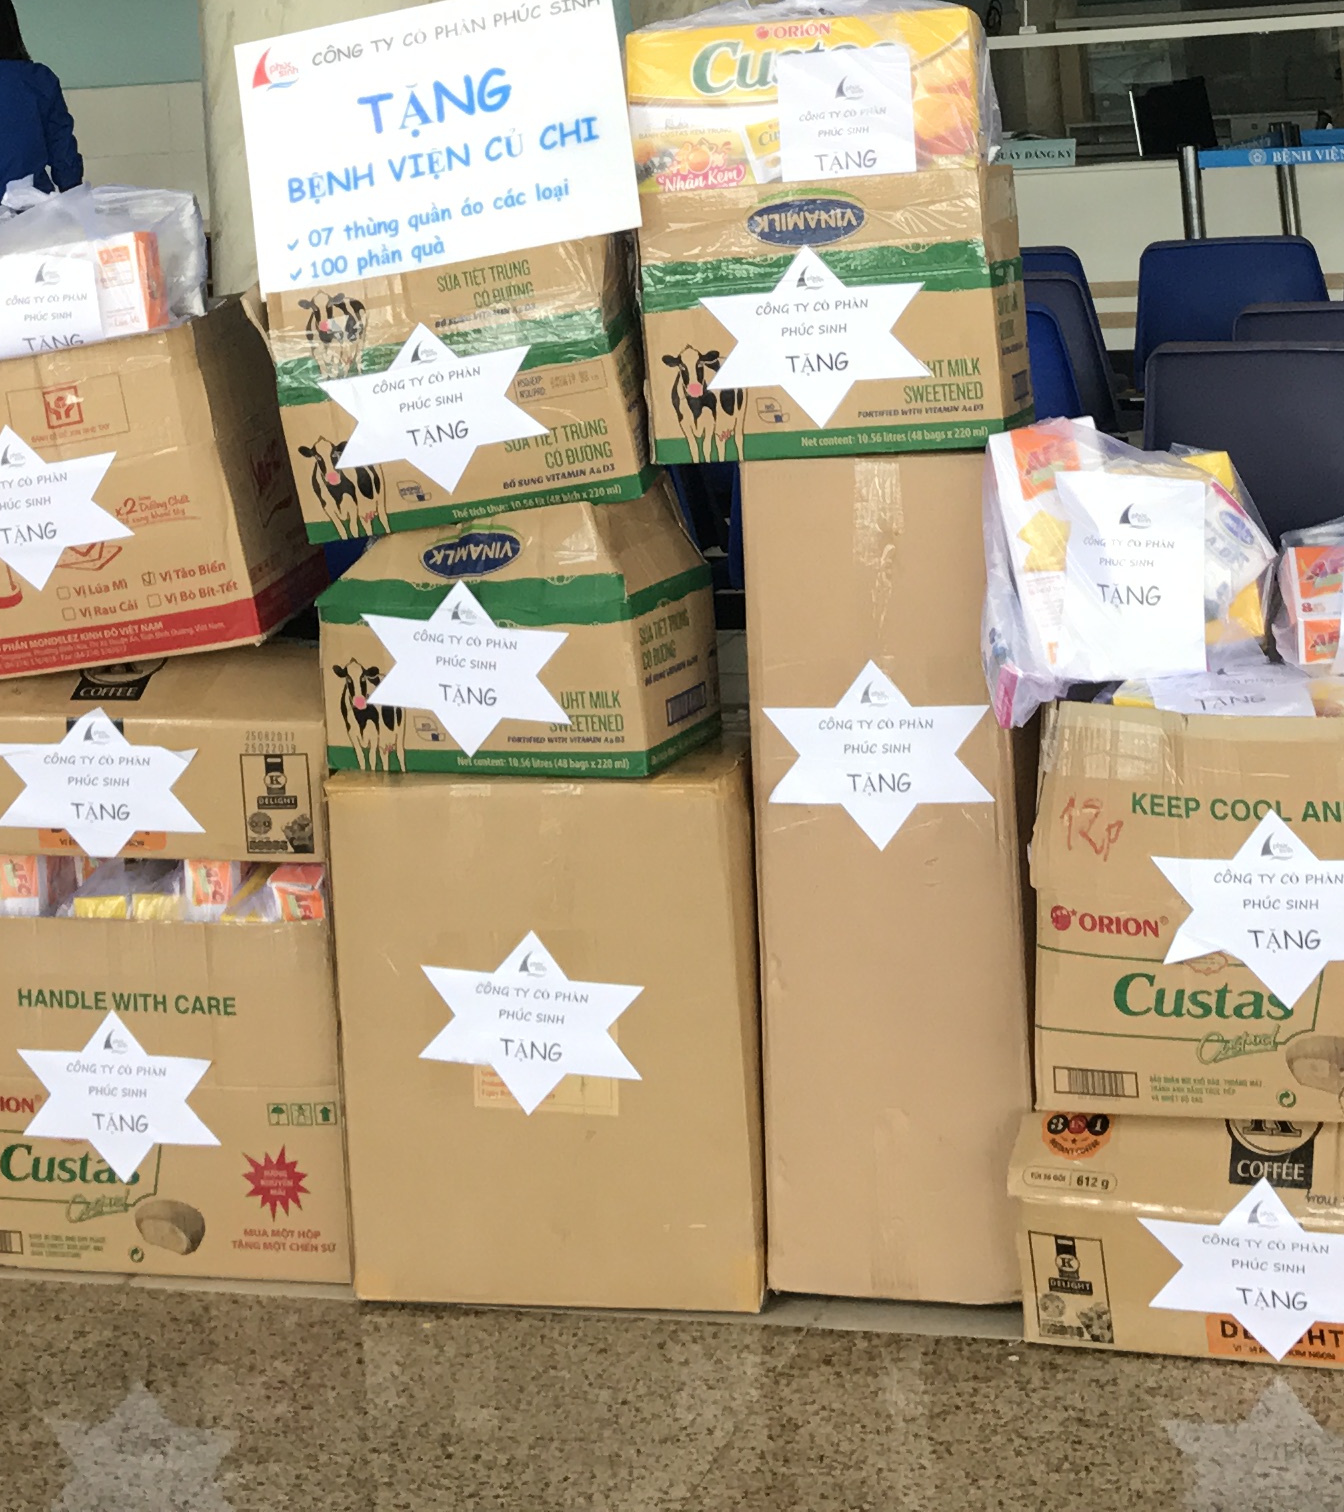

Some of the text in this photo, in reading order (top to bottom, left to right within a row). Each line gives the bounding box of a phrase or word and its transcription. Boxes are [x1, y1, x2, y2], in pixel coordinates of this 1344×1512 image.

[311, 43, 364, 67] CÔNG
[371, 37, 394, 53] TY
[494, 4, 542, 28] PHÚC
[774, 22, 831, 40] ORION
[357, 67, 512, 138] TẶNG
[287, 115, 600, 205] BỆNH VIỆN CỦ CHI
[814, 148, 878, 174] TẶNG
[663, 163, 740, 193] Nhân Kem
[308, 177, 570, 248] 07 thùng quần áo các loại
[755, 205, 858, 235] VINAMILK
[310, 234, 445, 280] 100 phần quà
[755, 298, 810, 316] CÔNG TY
[781, 321, 848, 338] PHÚC SINH
[785, 350, 850, 376] TẶNG
[399, 393, 464, 413] PHÚC SINH
[904, 383, 984, 406] SWEETENED
[406, 420, 469, 449] TẶNG
[0, 521, 58, 547] TẶNG
[1097, 582, 1162, 608] TẶNG
[79, 687, 137, 699] COFFEE
[438, 683, 498, 708] TẶNG
[819, 715, 873, 730] CÔNG TY
[843, 741, 911, 755] PHÚC SINH
[846, 772, 912, 797] TẶNG
[71, 801, 131, 823] TẶNG
[1077, 915, 1160, 939] ORION
[1248, 928, 1322, 953] TẶNG
[499, 1037, 563, 1062] TẶNG
[92, 1112, 149, 1134] TẶNG
[1236, 1159, 1305, 1182] COFFEE
[1236, 1287, 1308, 1313] TẶNG
